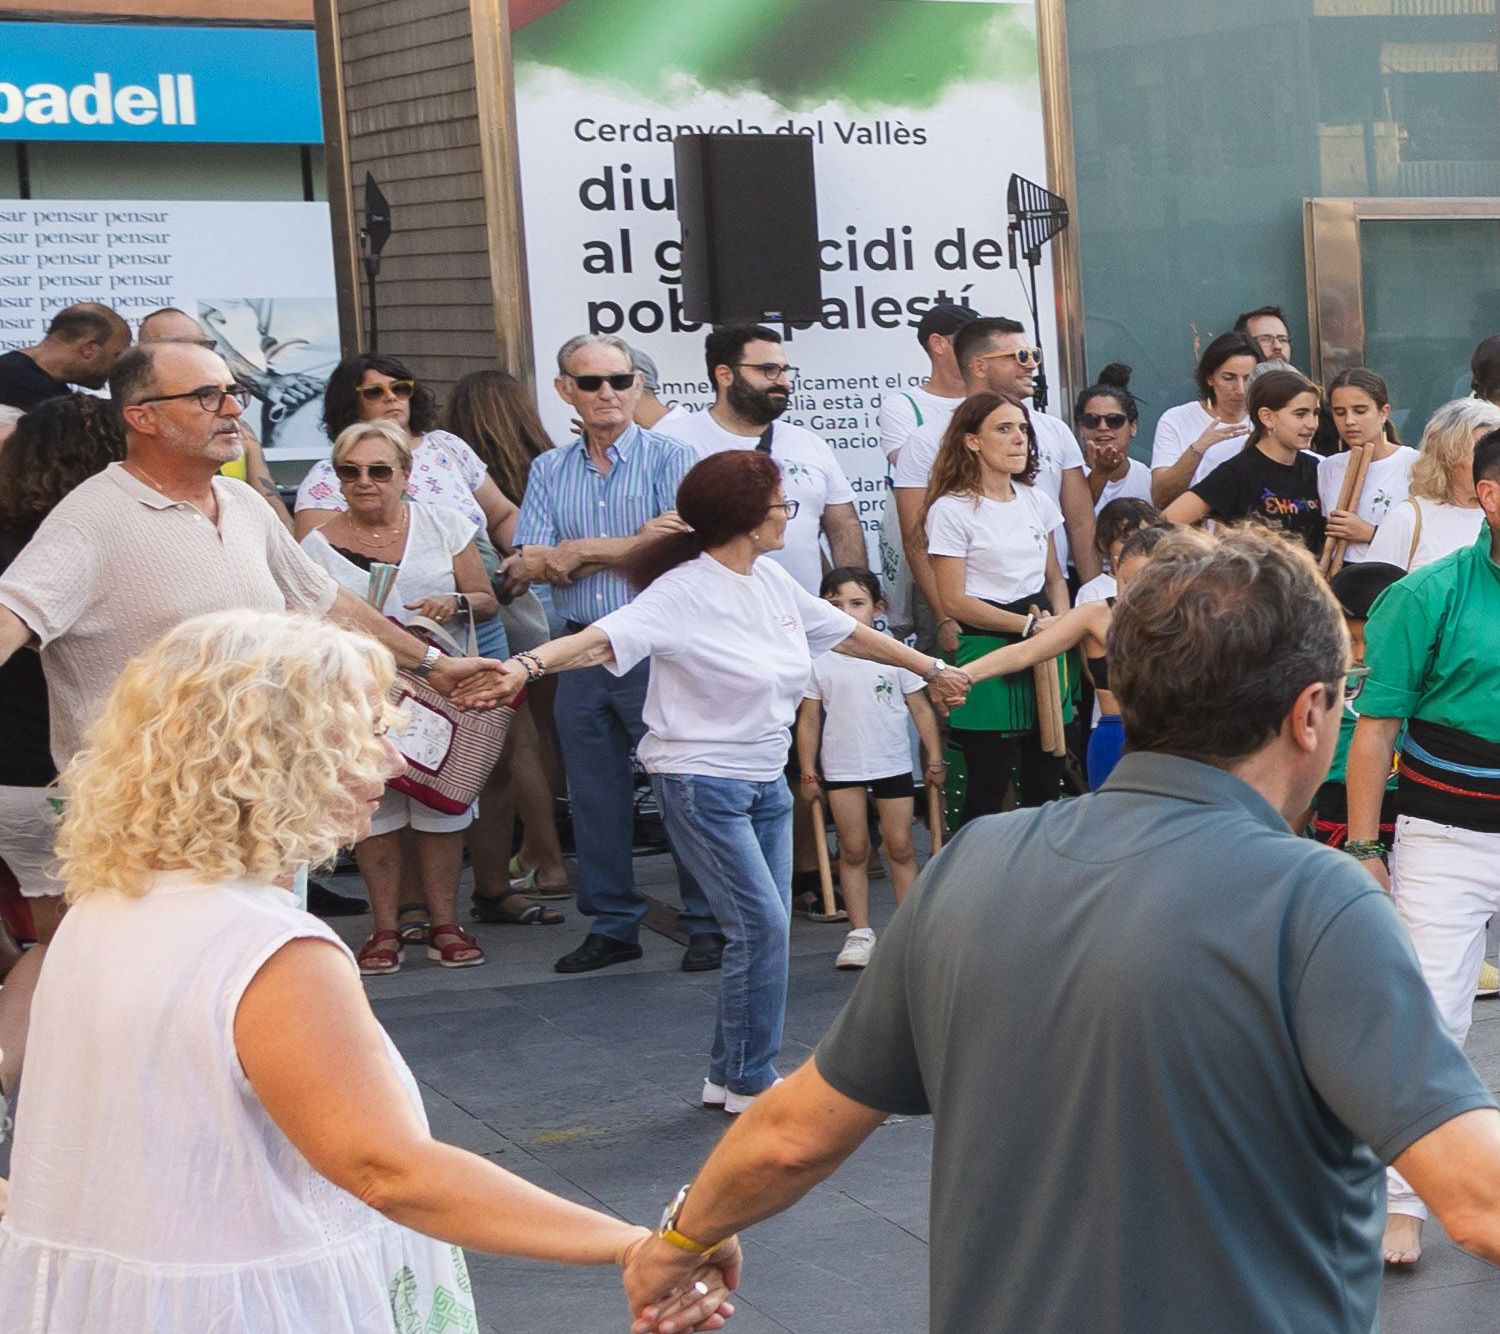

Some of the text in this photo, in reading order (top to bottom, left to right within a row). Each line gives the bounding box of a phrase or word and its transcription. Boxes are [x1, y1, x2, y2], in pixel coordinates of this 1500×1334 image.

[835, 121, 927, 146] Vallès
[579, 164, 675, 212] diu
[34, 211, 98, 226] pensar
[105, 211, 169, 226] pensar
[35, 233, 100, 248] pensar
[107, 233, 171, 248] pensar
[582, 228, 633, 274] al
[934, 227, 1018, 270] del
[37, 254, 101, 269] pensar
[108, 254, 172, 269] pensar
[38, 275, 103, 290] pensar
[110, 275, 173, 290] pensar
[111, 296, 175, 311] pensar
[885, 373, 902, 388] el
[823, 394, 864, 410] està
[811, 415, 858, 430] Gaza
